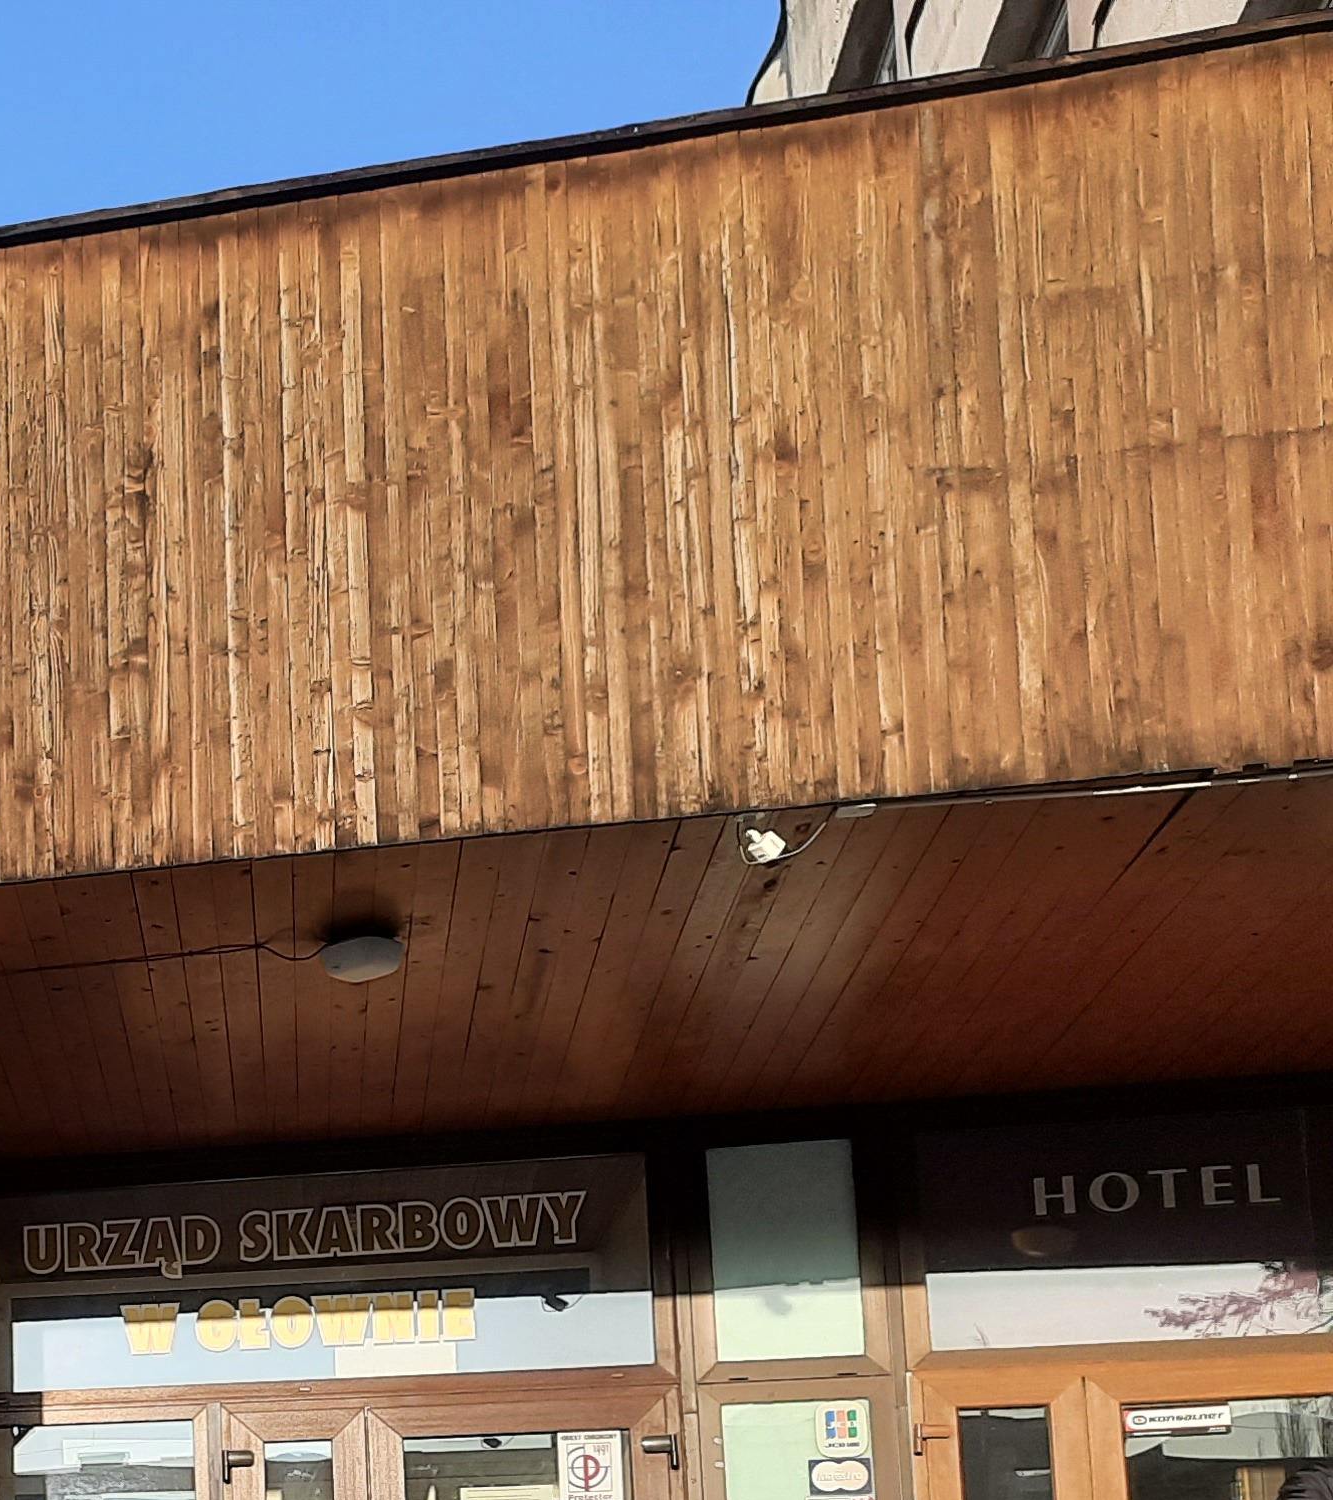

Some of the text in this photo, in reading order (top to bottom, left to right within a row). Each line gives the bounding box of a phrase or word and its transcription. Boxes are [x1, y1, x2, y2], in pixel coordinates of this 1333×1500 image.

[1032, 1163, 1282, 1217] HOTEL
[22, 1189, 587, 1280] URZĄD SKARBOWY
[120, 1288, 477, 1356] W GŁOWNIE
